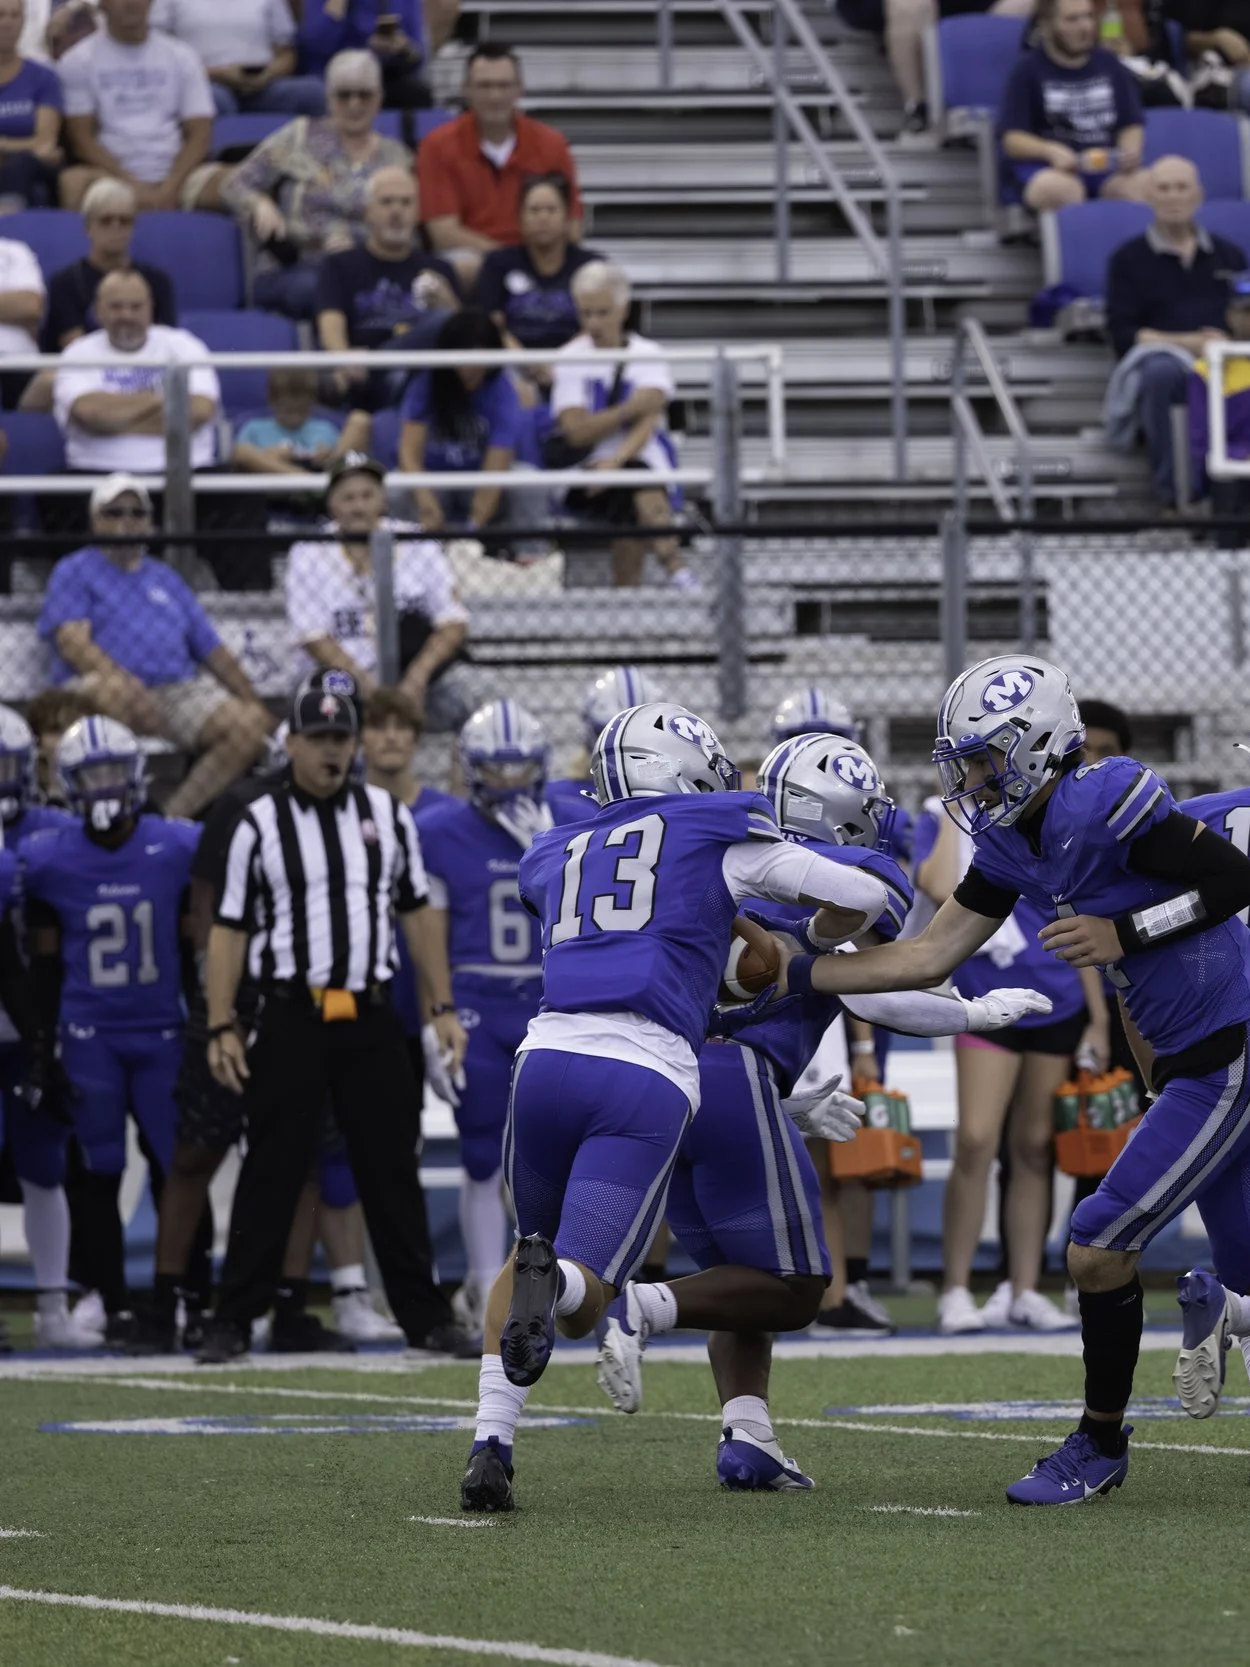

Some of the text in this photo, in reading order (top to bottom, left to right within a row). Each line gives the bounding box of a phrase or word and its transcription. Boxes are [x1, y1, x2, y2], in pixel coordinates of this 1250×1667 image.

[984, 671, 1033, 712] M
[673, 716, 717, 748] M
[838, 756, 876, 790] M
[550, 812, 667, 946] 13
[87, 899, 160, 987] 21
[490, 878, 531, 963] 6
